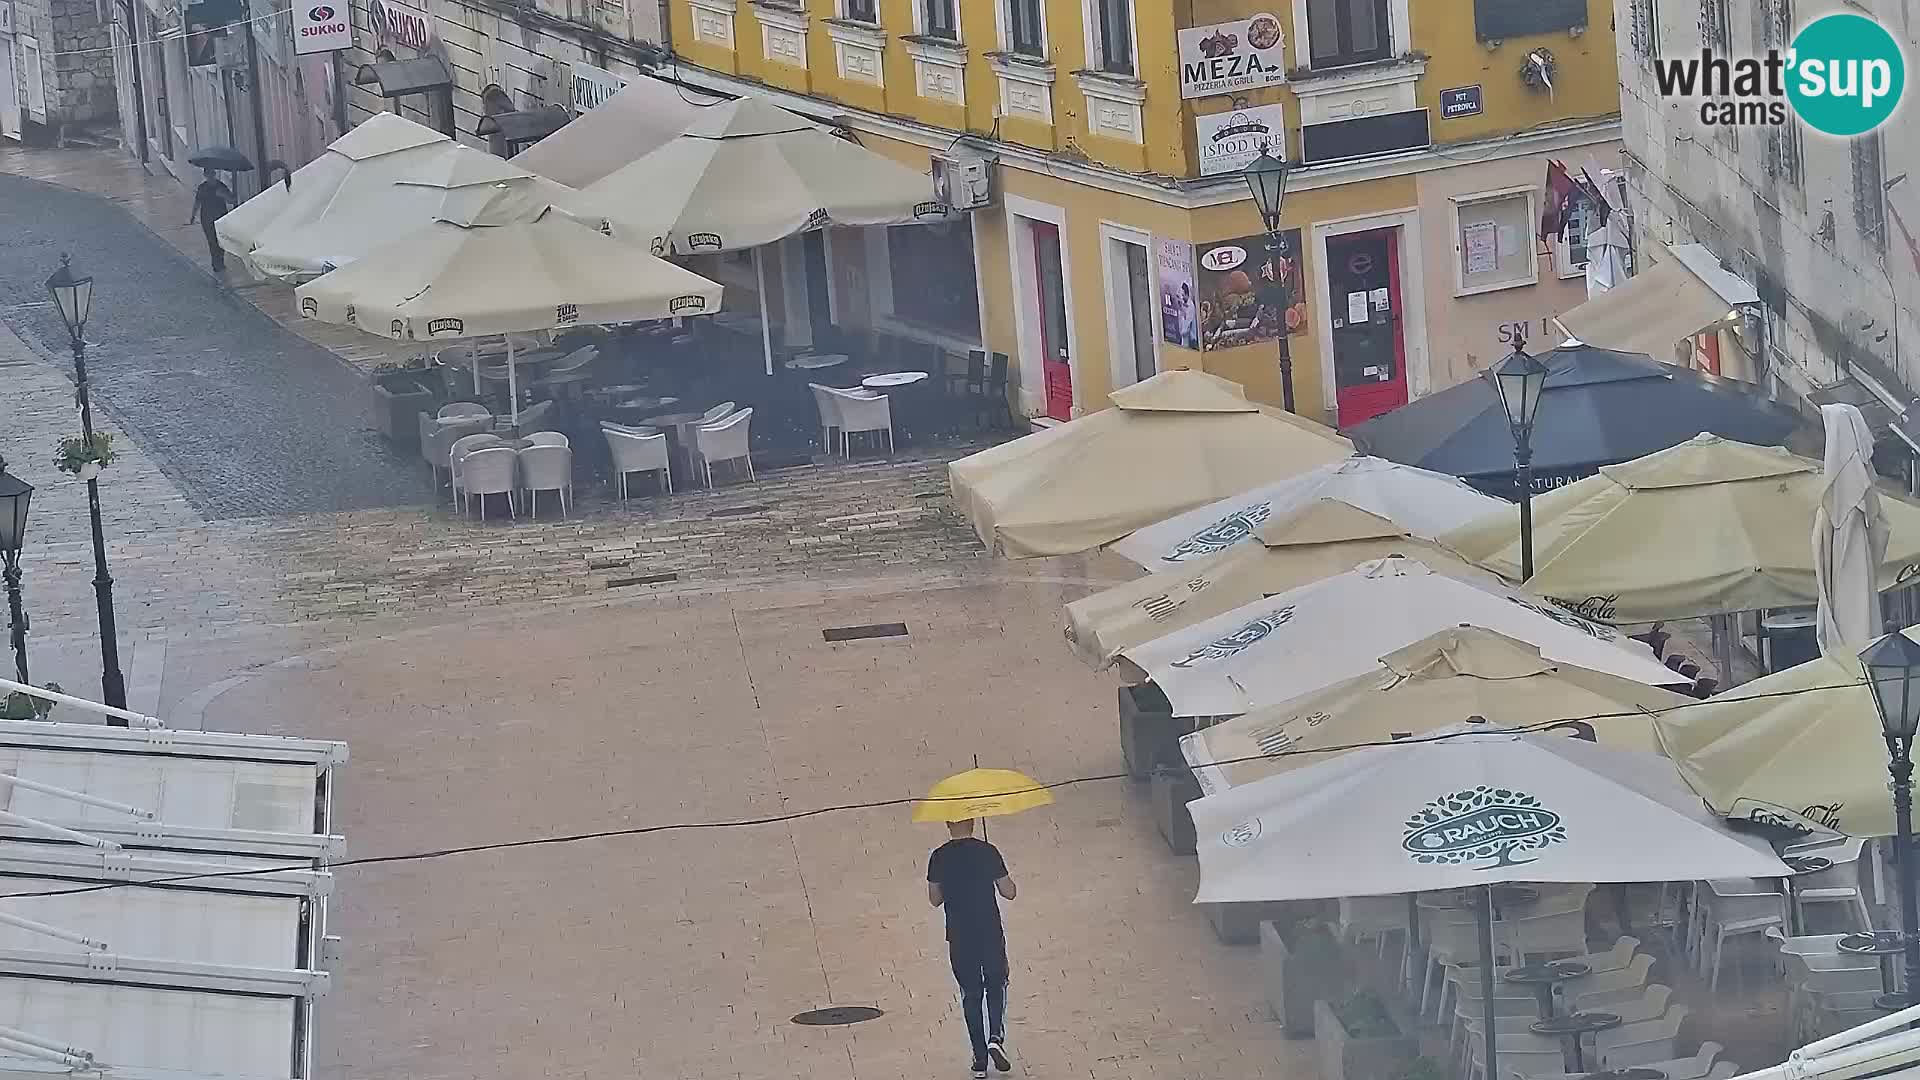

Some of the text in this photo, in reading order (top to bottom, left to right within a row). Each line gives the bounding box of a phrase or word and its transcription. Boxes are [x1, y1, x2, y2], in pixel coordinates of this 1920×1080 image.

[301, 23, 346, 37] SUKNO
[387, 7, 427, 48] SUKNO
[1184, 53, 1263, 84] MEZA
[1194, 80, 1227, 91] PIZZERIA
[1234, 75, 1255, 86] GRILL
[1203, 139, 1248, 158] ISPOD
[1443, 813, 1542, 843] RAUCH
